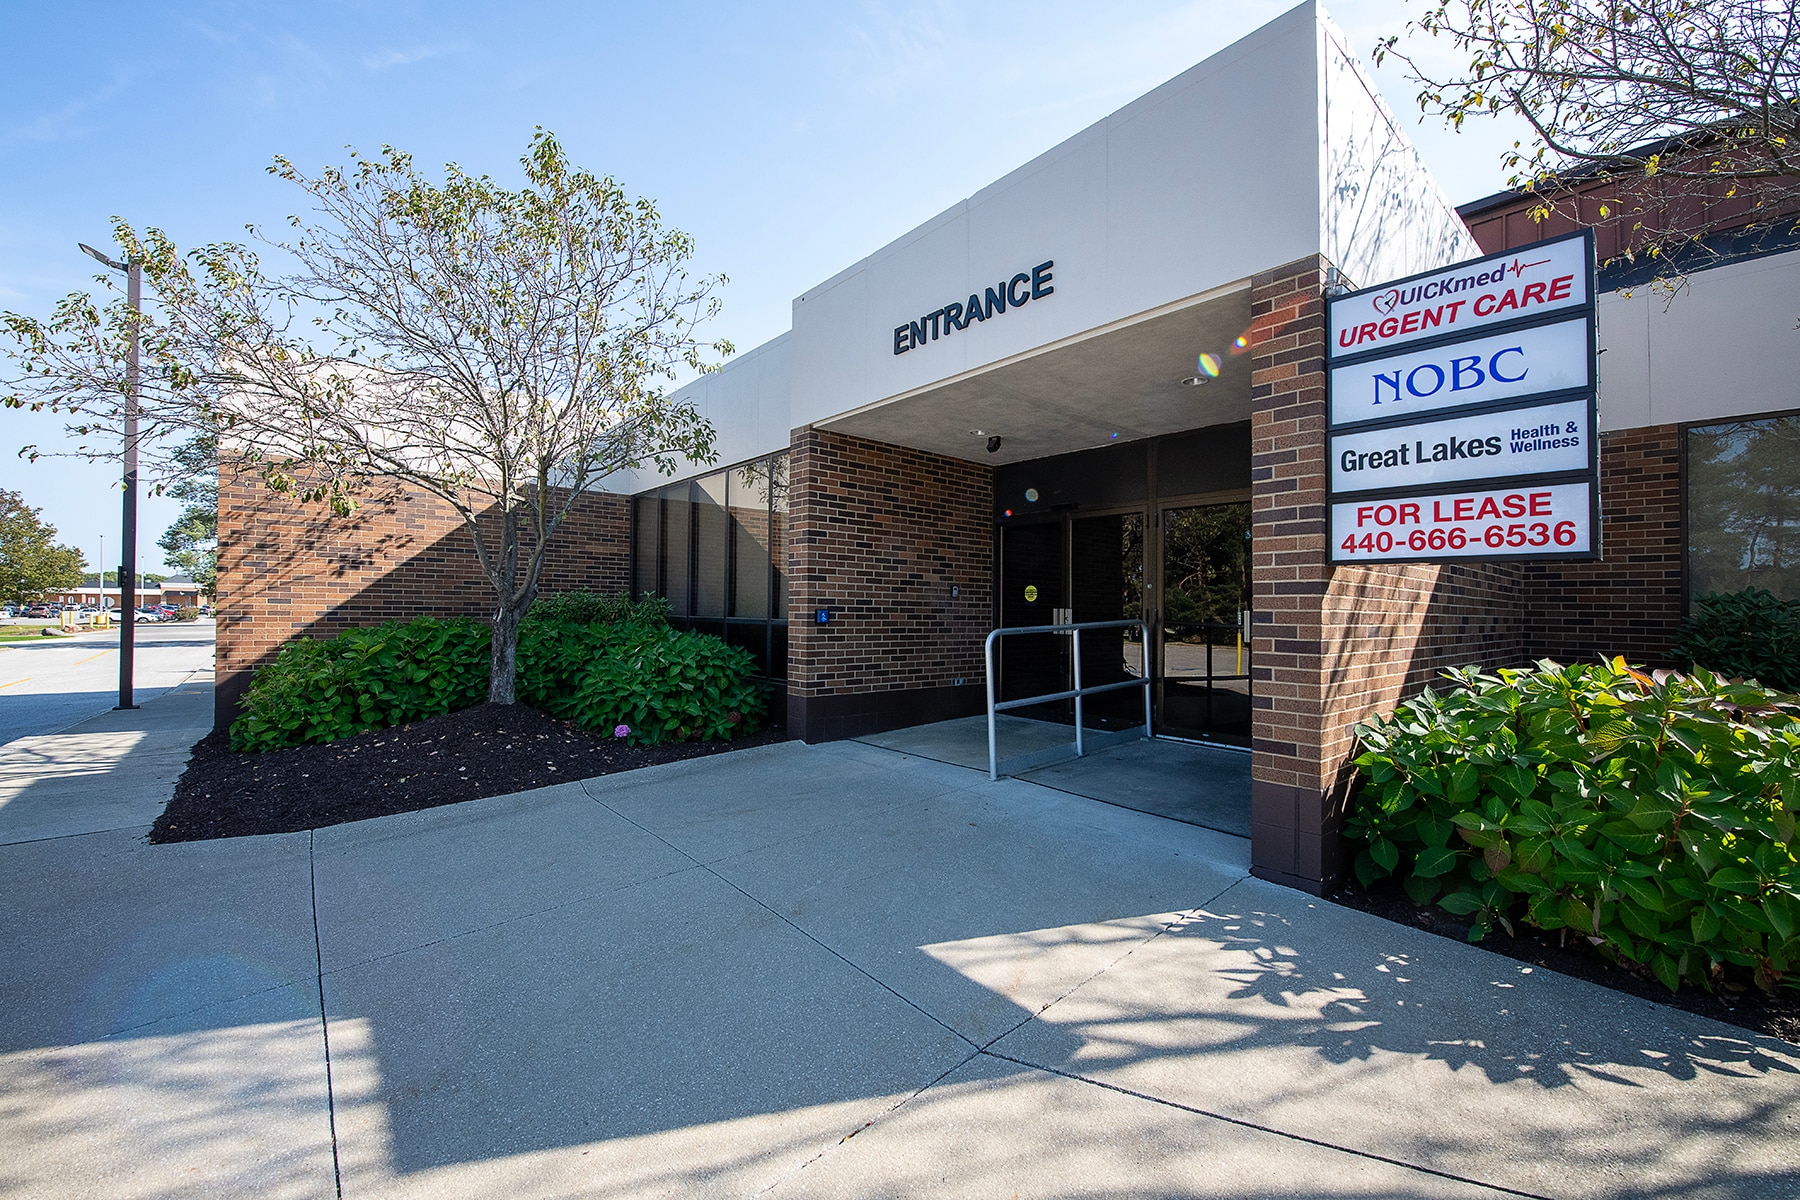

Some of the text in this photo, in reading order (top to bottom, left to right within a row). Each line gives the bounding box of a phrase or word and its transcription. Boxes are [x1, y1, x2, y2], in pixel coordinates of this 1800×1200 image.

[893, 260, 1054, 356] ENTRANCE
[1339, 274, 1574, 348] URGENT CARE
[1372, 346, 1529, 405] NOBC
[1510, 434, 1580, 454] Wellness
[1511, 420, 1578, 441] Health &
[1341, 435, 1502, 472] Great Lakes
[1357, 492, 1553, 528] FOR LEASE
[1341, 520, 1577, 554] 440-666-6536
